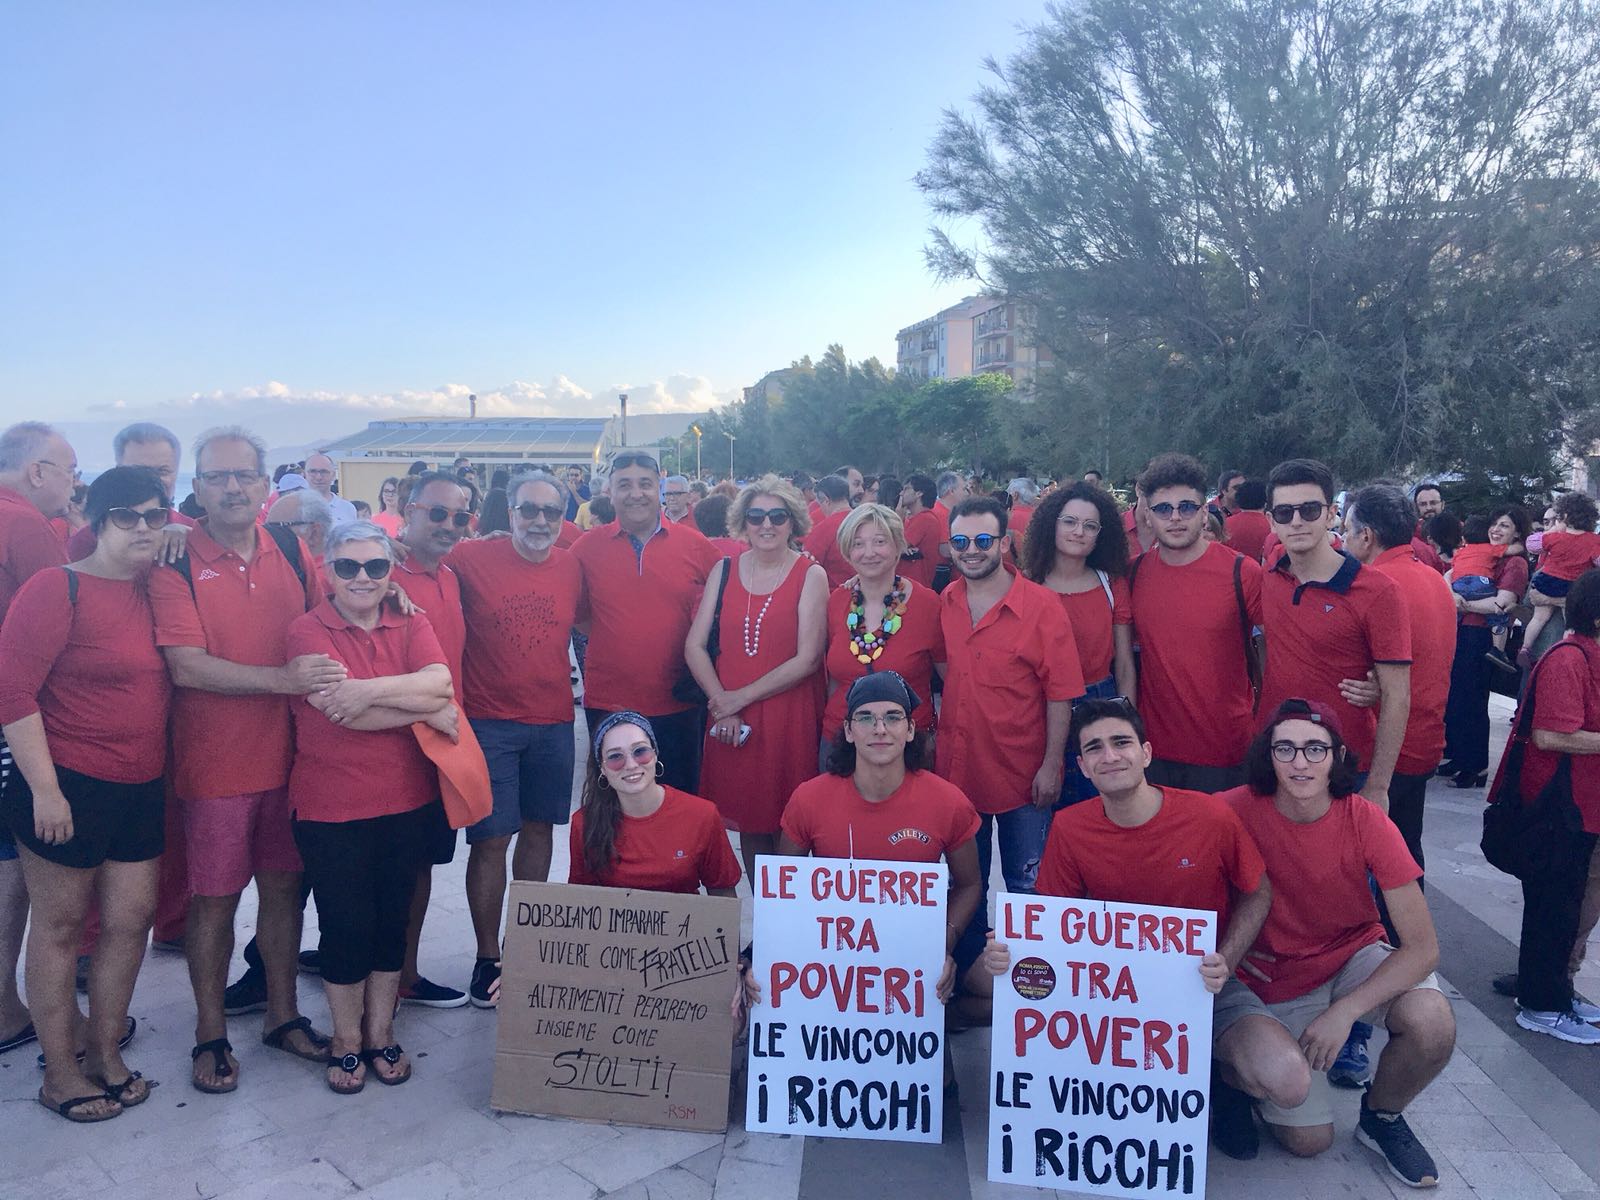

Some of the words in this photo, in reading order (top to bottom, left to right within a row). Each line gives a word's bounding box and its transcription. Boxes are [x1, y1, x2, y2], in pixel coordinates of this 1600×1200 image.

[891, 830, 928, 842] BAILEYS
[761, 865, 798, 899] LE
[811, 867, 939, 907] GUERRE
[517, 902, 602, 930] DOBBIAMO
[608, 908, 669, 936] IMPARARE
[678, 914, 691, 937] A
[816, 916, 880, 953] TRA
[1004, 902, 1046, 941] LE
[1060, 907, 1208, 957] GUERRE
[539, 939, 591, 968] VIVERE
[600, 946, 637, 971] COME
[638, 928, 731, 988] FRATELLI
[1066, 961, 1139, 1004] TRA
[633, 995, 708, 1023] PERIREMO
[536, 1019, 597, 1041] INSIEME
[612, 1025, 658, 1047] COME
[753, 1022, 788, 1057] LE
[996, 1071, 1034, 1109] LE
